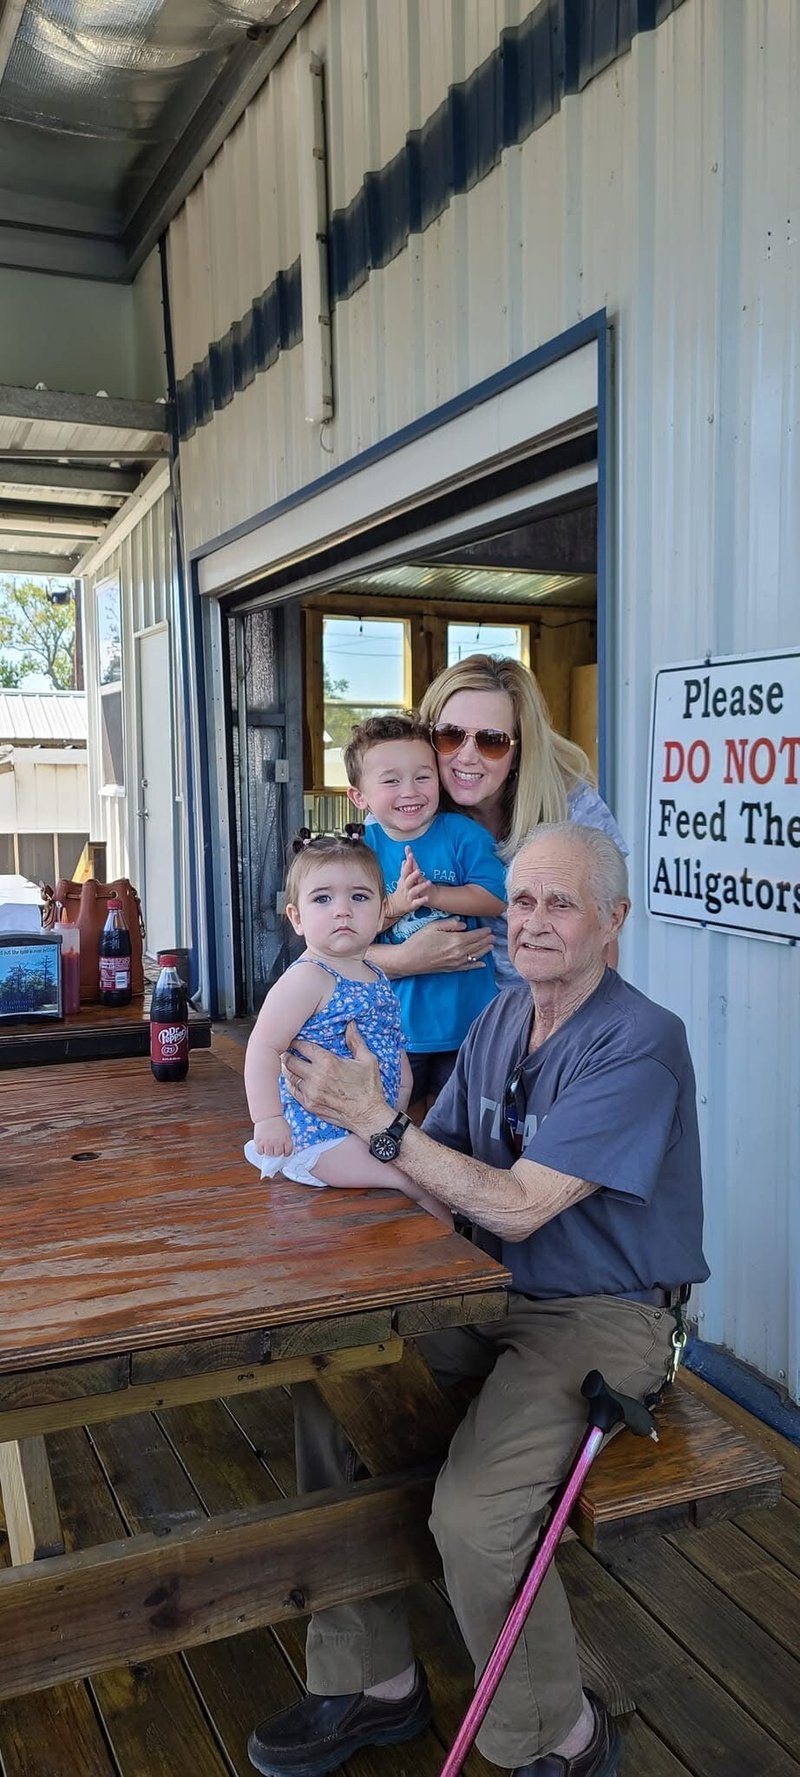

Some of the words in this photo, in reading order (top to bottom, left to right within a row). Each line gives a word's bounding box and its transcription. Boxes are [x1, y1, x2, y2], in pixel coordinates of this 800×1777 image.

[683, 676, 784, 719] Please
[662, 739, 711, 784] DO
[723, 736, 800, 785] NOT
[658, 799, 727, 842] Feed
[740, 800, 800, 849] The
[433, 869, 457, 882] PAR
[160, 1029, 186, 1045] Pepper
